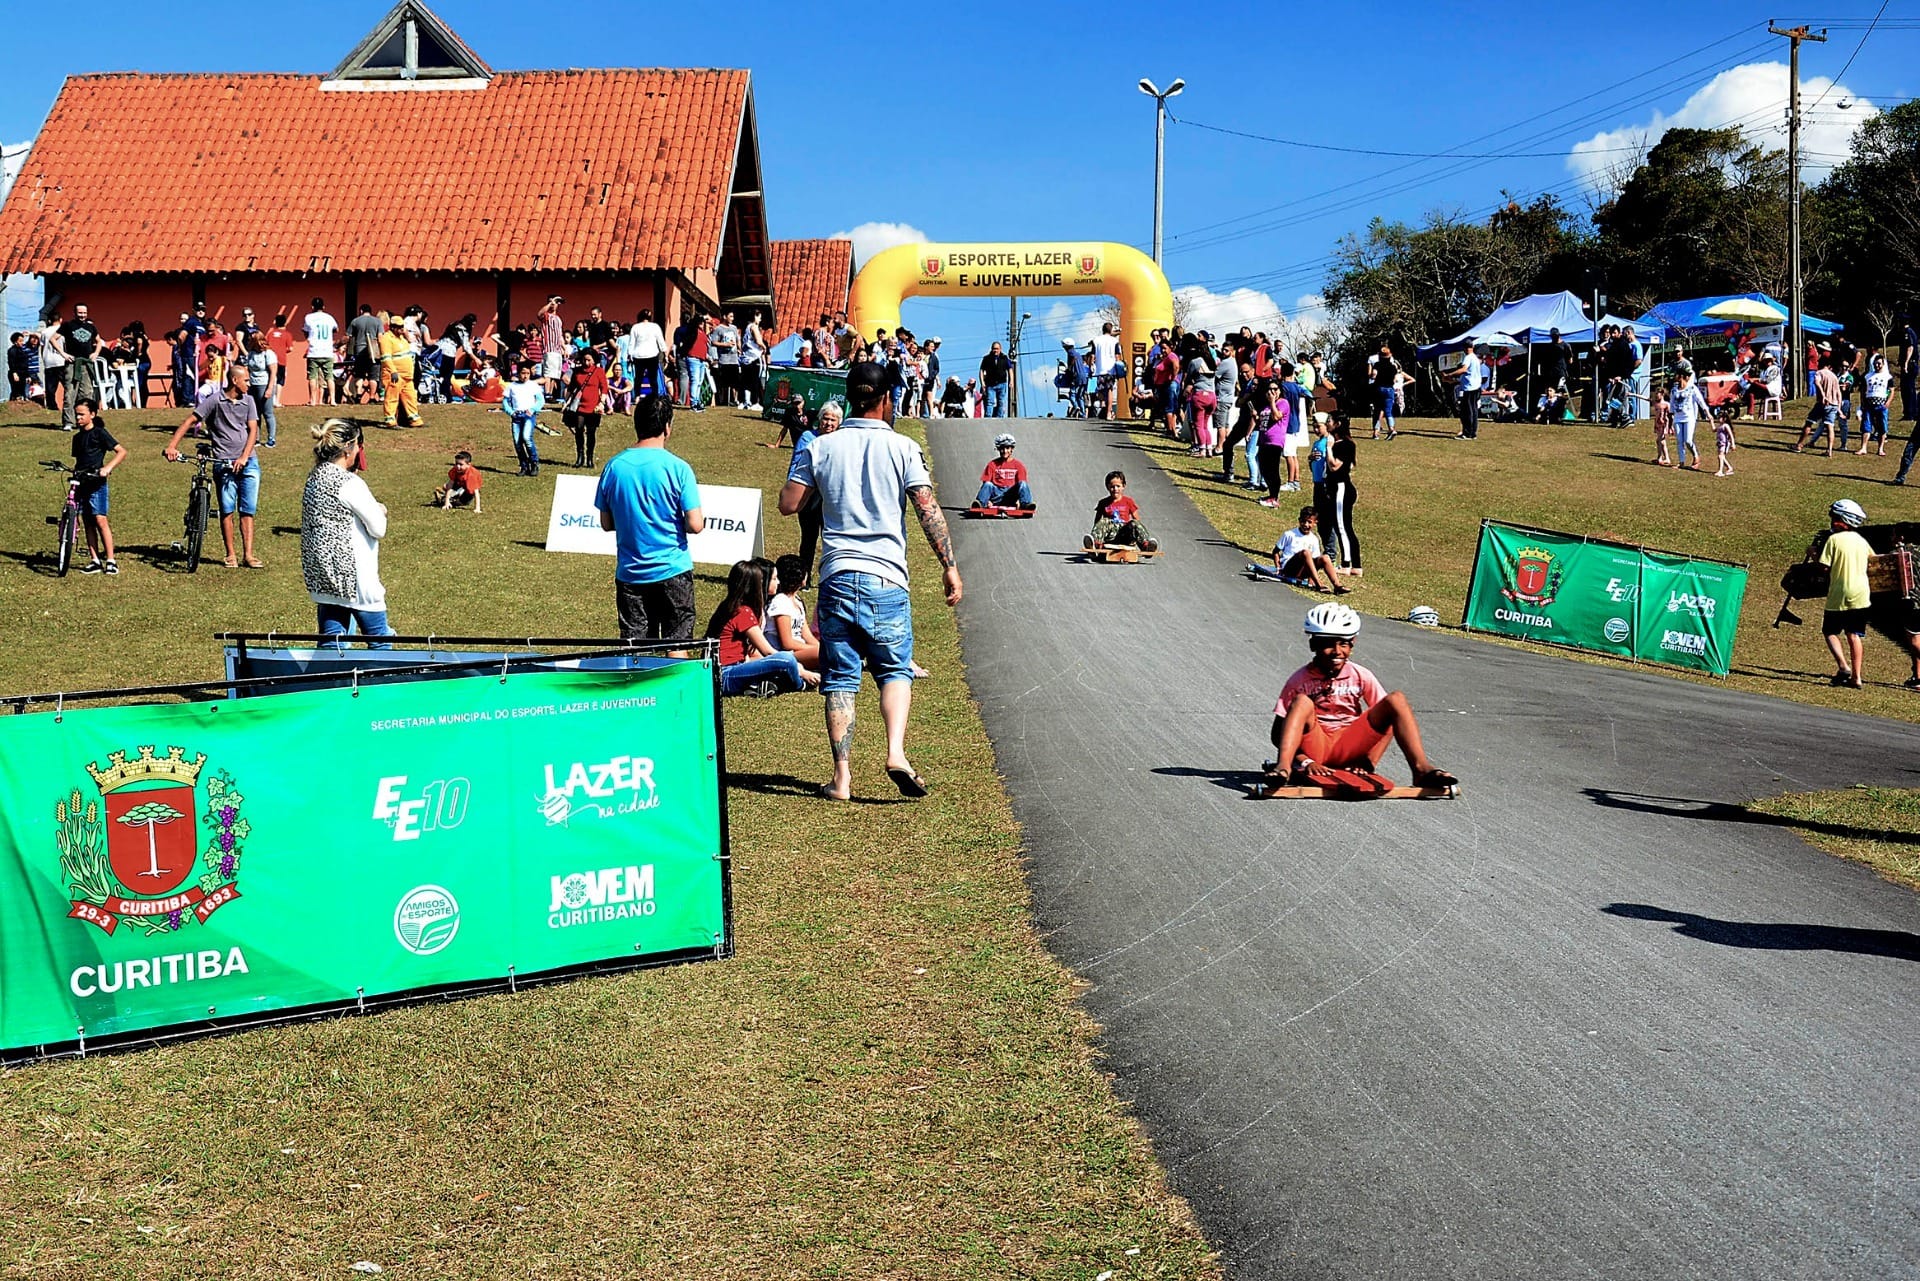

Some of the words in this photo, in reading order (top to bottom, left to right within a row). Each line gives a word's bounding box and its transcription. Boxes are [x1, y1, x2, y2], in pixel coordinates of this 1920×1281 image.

[949, 253, 1020, 268] ESPORTE,
[1025, 252, 1072, 266] LAZER
[959, 274, 968, 287] E
[973, 273, 1062, 287] JUVENTUDE
[703, 517, 746, 533] ITIBA
[1671, 590, 1716, 612] LAZER
[1495, 608, 1552, 628] CURITIBA
[371, 716, 436, 731] SECRETARIA
[438, 711, 492, 725] MUNICIPAL
[495, 708, 509, 719] DO
[559, 701, 590, 714] LAZER
[592, 701, 599, 711] E
[600, 696, 657, 710] JUVENTUDE
[544, 755, 657, 798] LAZER
[598, 806, 616, 819] na
[618, 790, 661, 815] cidade
[549, 864, 655, 913] JOVEM
[77, 904, 112, 928] 29-3
[119, 893, 191, 915] CURITIBA
[198, 887, 232, 917] 1693
[405, 899, 446, 912] AMIGOS
[408, 906, 452, 920] ESPORTE
[547, 901, 656, 929] CURITIBANO
[70, 946, 250, 998] CURITIBA
